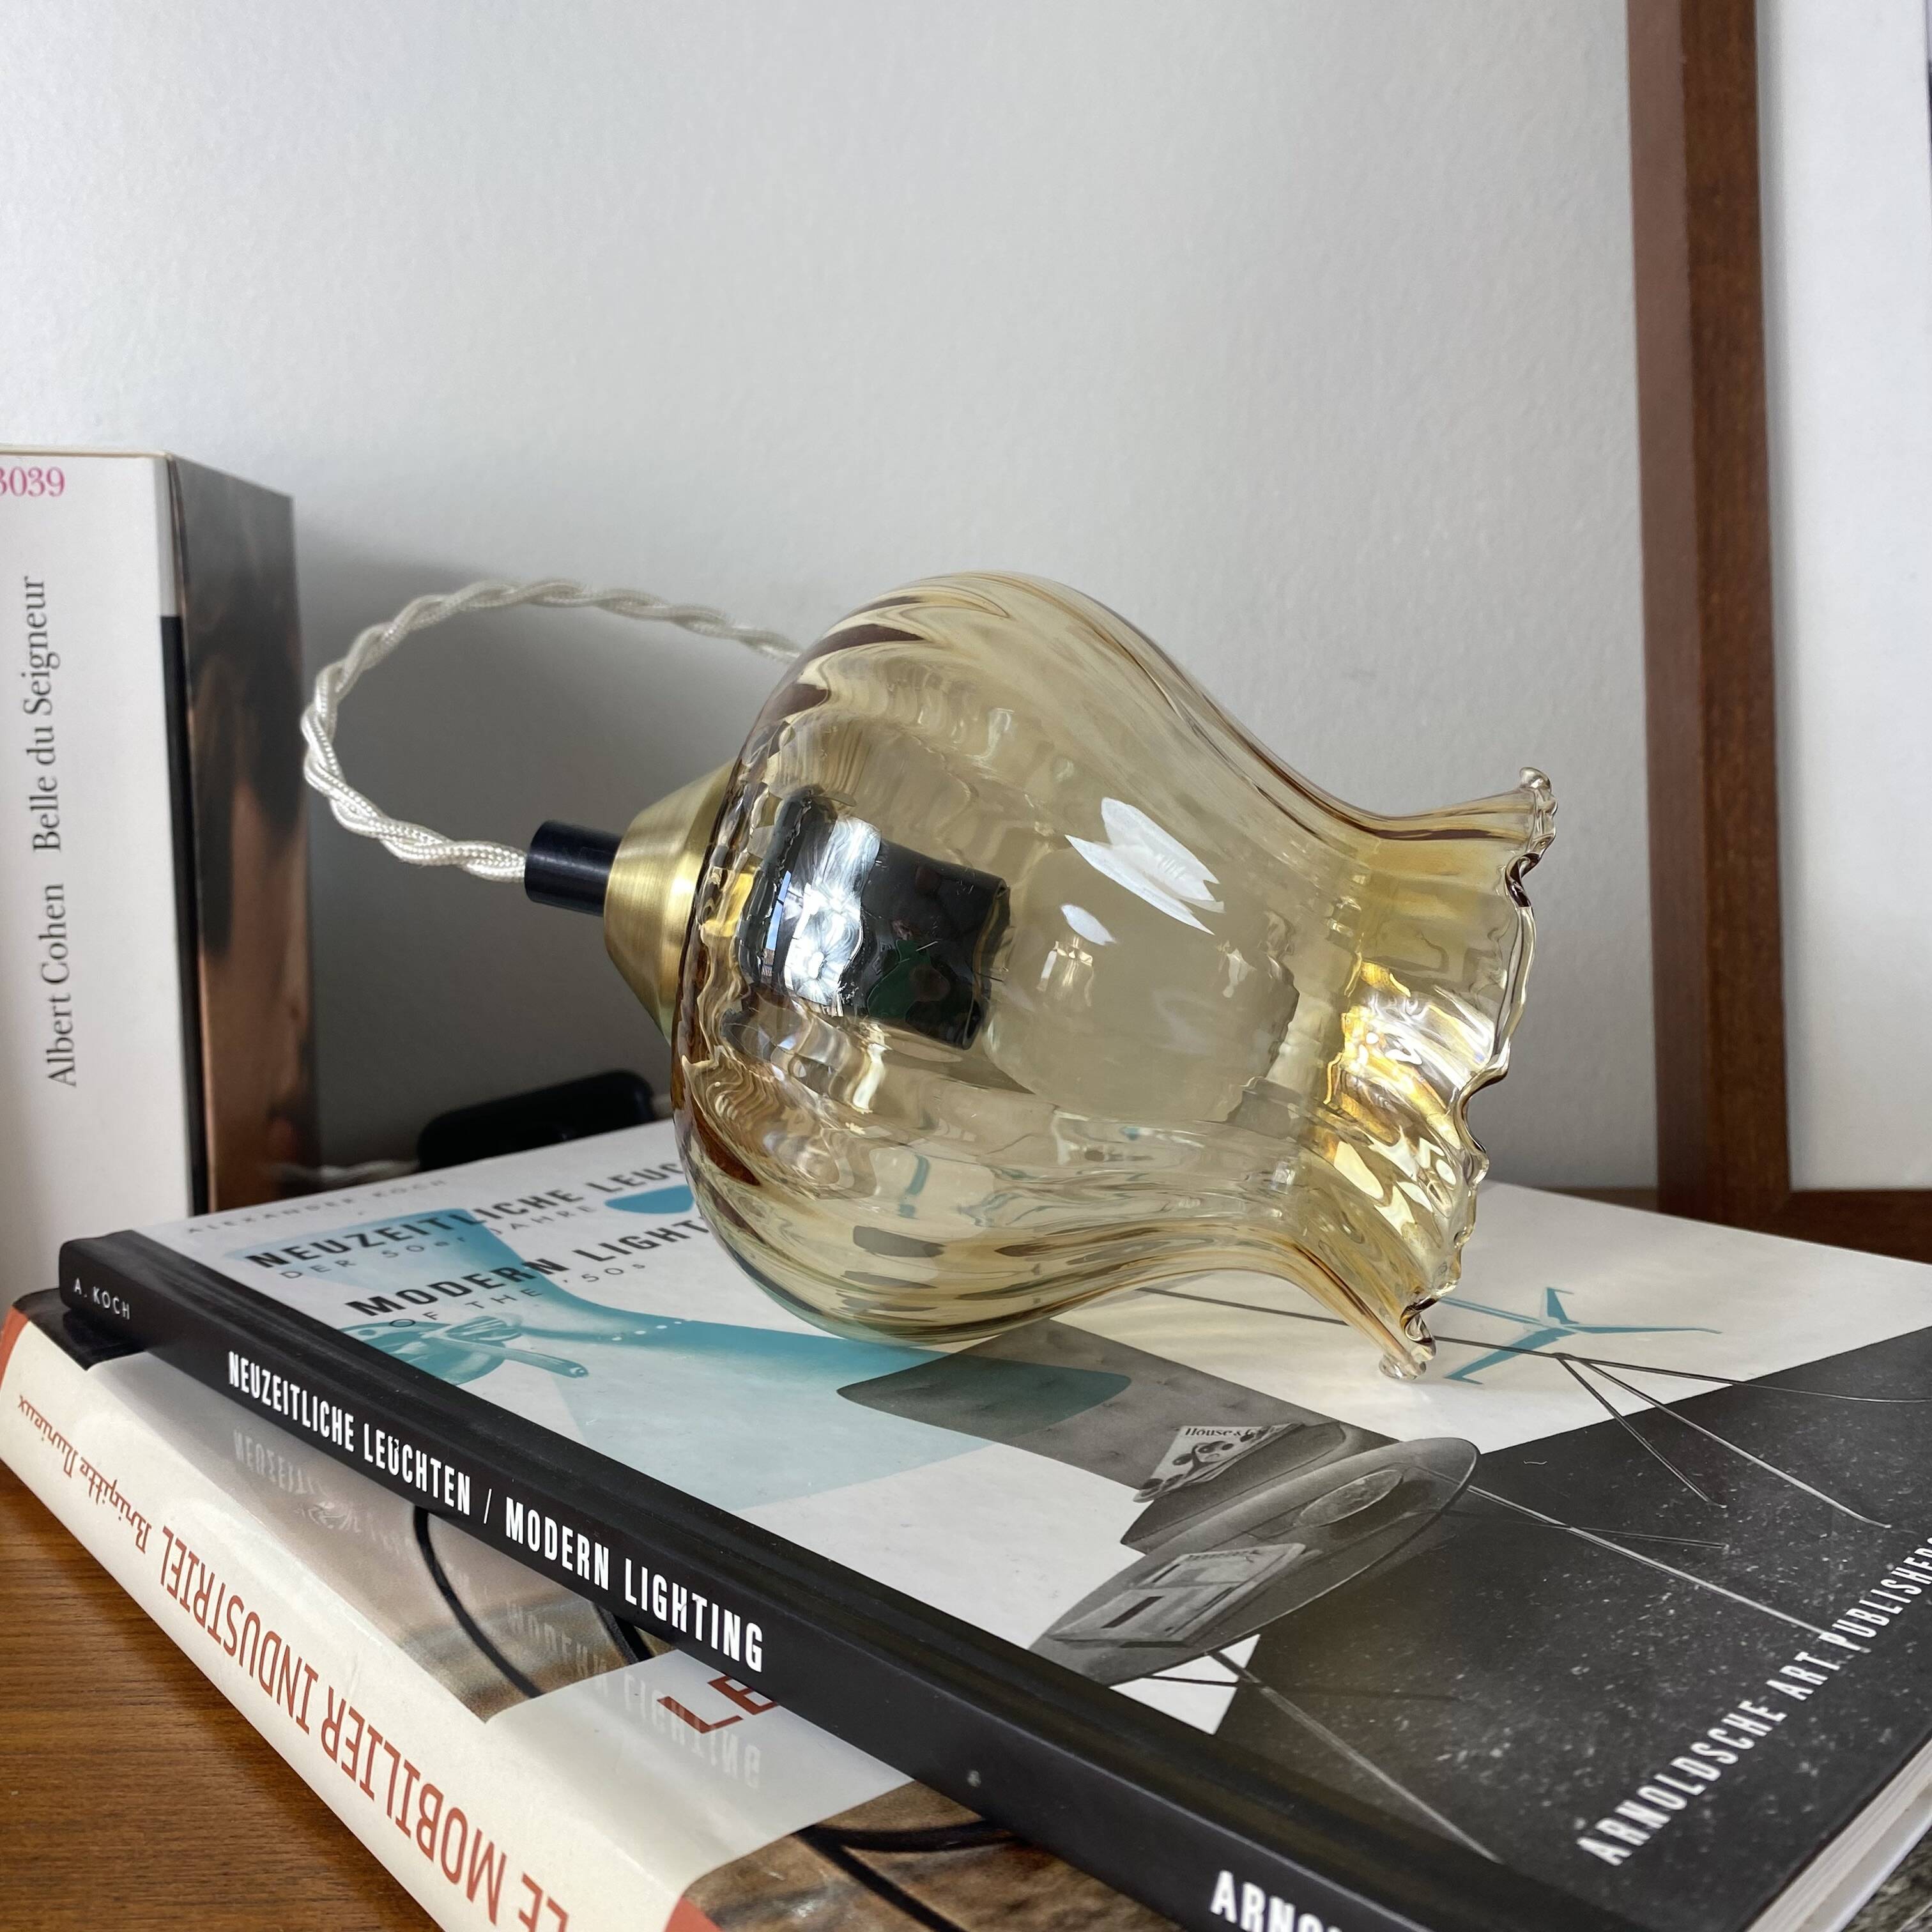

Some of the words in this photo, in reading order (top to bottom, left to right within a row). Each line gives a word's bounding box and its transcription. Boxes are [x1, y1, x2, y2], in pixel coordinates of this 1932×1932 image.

[22, 576, 60, 716] Seigneur
[26, 726, 56, 765] du
[29, 775, 61, 852] Belle
[38, 883, 70, 985] Cohen
[45, 992, 77, 1087] Albert
[245, 1188, 585, 1268] NEUZEITLICHE
[586, 1163, 684, 1193] LEUC
[280, 1259, 356, 1279] DER
[487, 1204, 597, 1235] JAHRE
[73, 1278, 88, 1298] A.
[93, 1286, 130, 1320] KOCH
[345, 1258, 570, 1316] MODERN
[572, 1216, 710, 1262] LIGHT
[388, 1311, 440, 1328] OF
[464, 1287, 544, 1310] THE
[1184, 1428, 1233, 1437] House
[80, 1457, 152, 1554] Brigitte
[227, 1351, 355, 1453] NEUZEITLICHE
[363, 1422, 471, 1516] LEUCHTEN
[505, 1497, 610, 1591] MODERN
[625, 1556, 763, 1673] LIGHTING
[160, 1525, 319, 1735] INDUSTRIEL
[1576, 1700, 1788, 1866] ARNOLDSCHE
[1765, 1652, 1841, 1701] ART
[1818, 1537, 1932, 1651] PUBLISHE
[321, 1685, 507, 1926] MOBILIER
[1210, 1870, 1343, 1932] ARN
